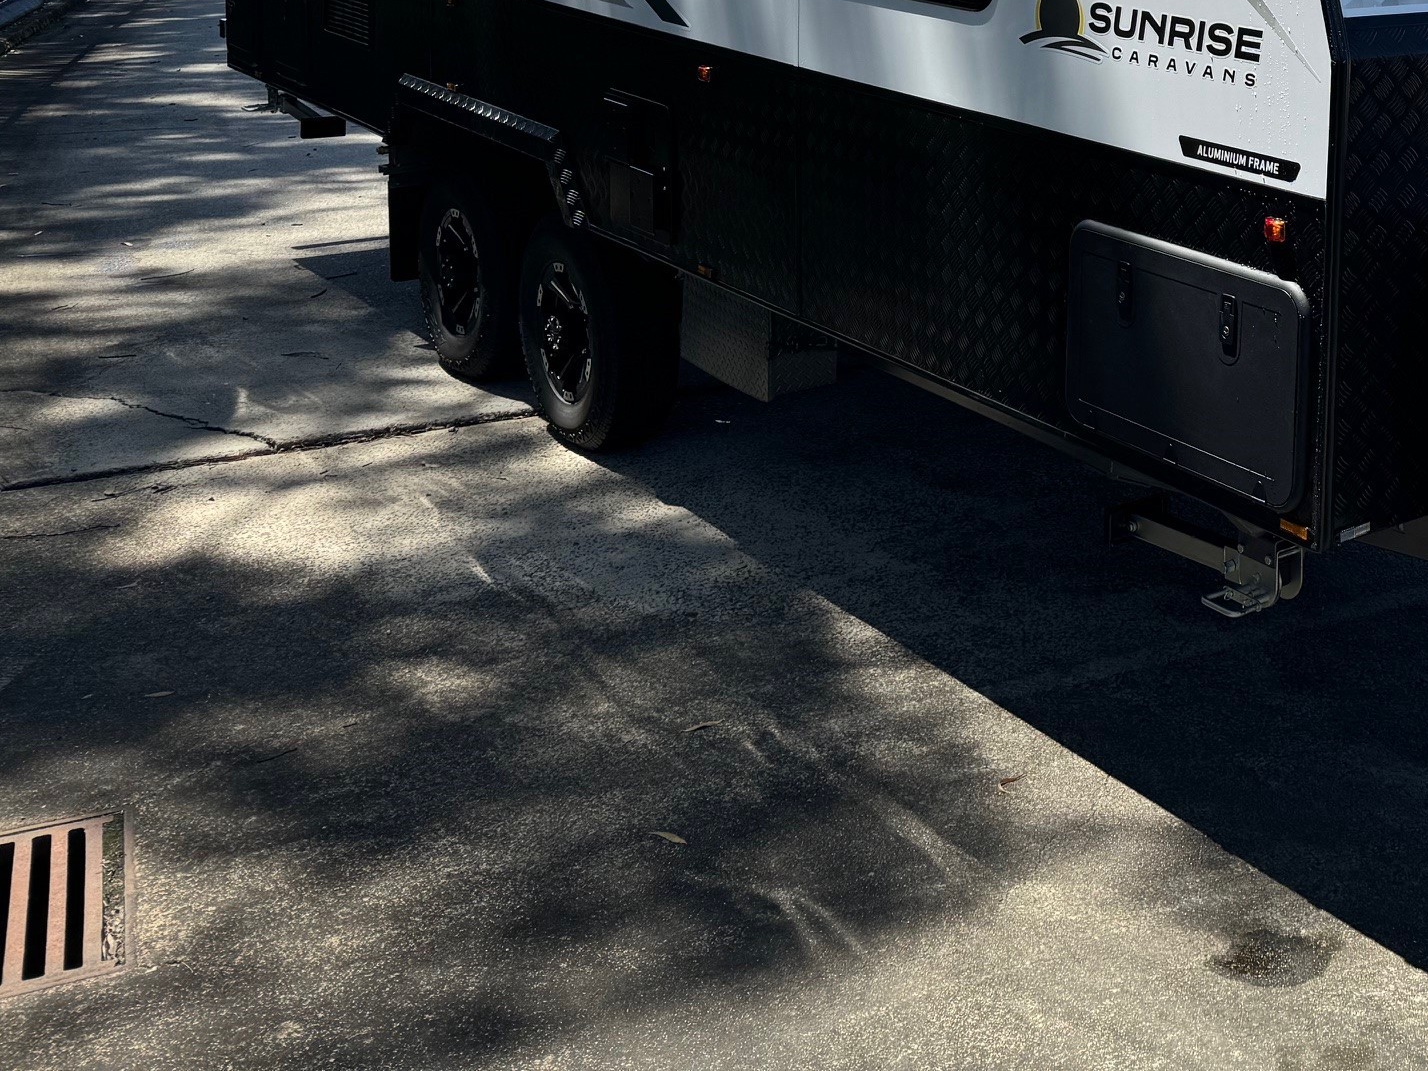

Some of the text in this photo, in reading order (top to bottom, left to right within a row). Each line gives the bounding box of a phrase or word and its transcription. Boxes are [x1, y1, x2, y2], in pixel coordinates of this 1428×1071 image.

[1088, 2, 1264, 63] SUNRISE
[1111, 46, 1256, 87] CARAVANS
[1196, 144, 1280, 175] ALUMINIUM FRAME
